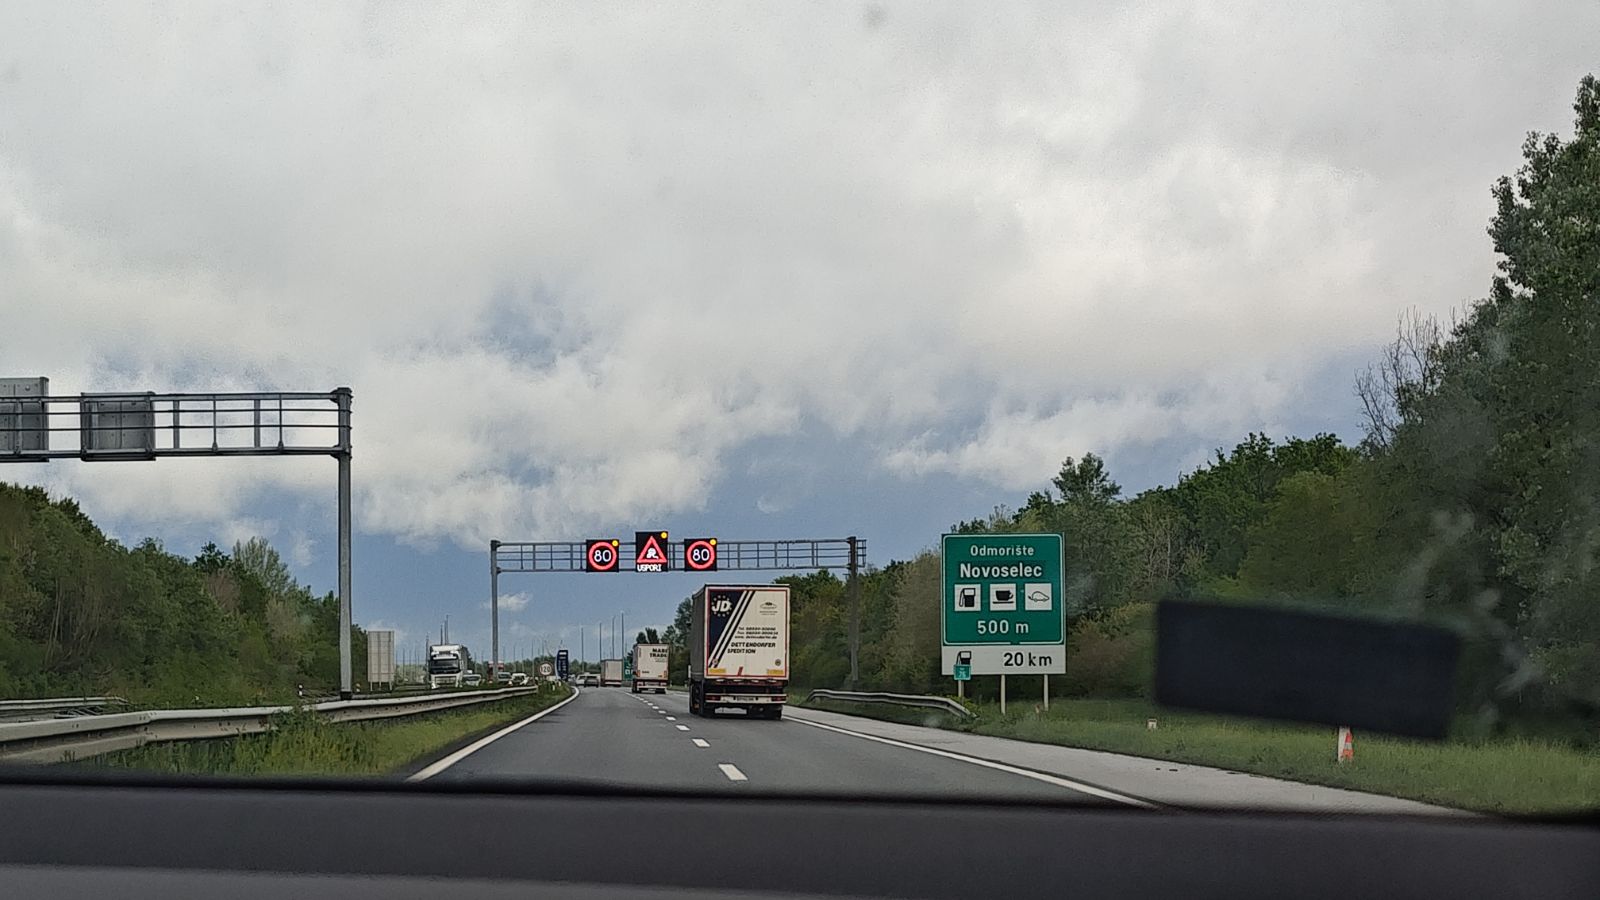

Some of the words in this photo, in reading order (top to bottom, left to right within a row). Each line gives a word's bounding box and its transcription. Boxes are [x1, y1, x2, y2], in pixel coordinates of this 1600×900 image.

[594, 549, 612, 562] 80
[692, 549, 710, 561] 80
[970, 545, 1035, 556] Odmorište
[637, 564, 662, 572] USPORI
[960, 562, 1042, 578] Novoselec
[711, 600, 731, 612] JD
[977, 620, 1009, 634] 500
[1015, 623, 1029, 634] m
[1003, 652, 1024, 667] 20
[1028, 652, 1052, 667] km
